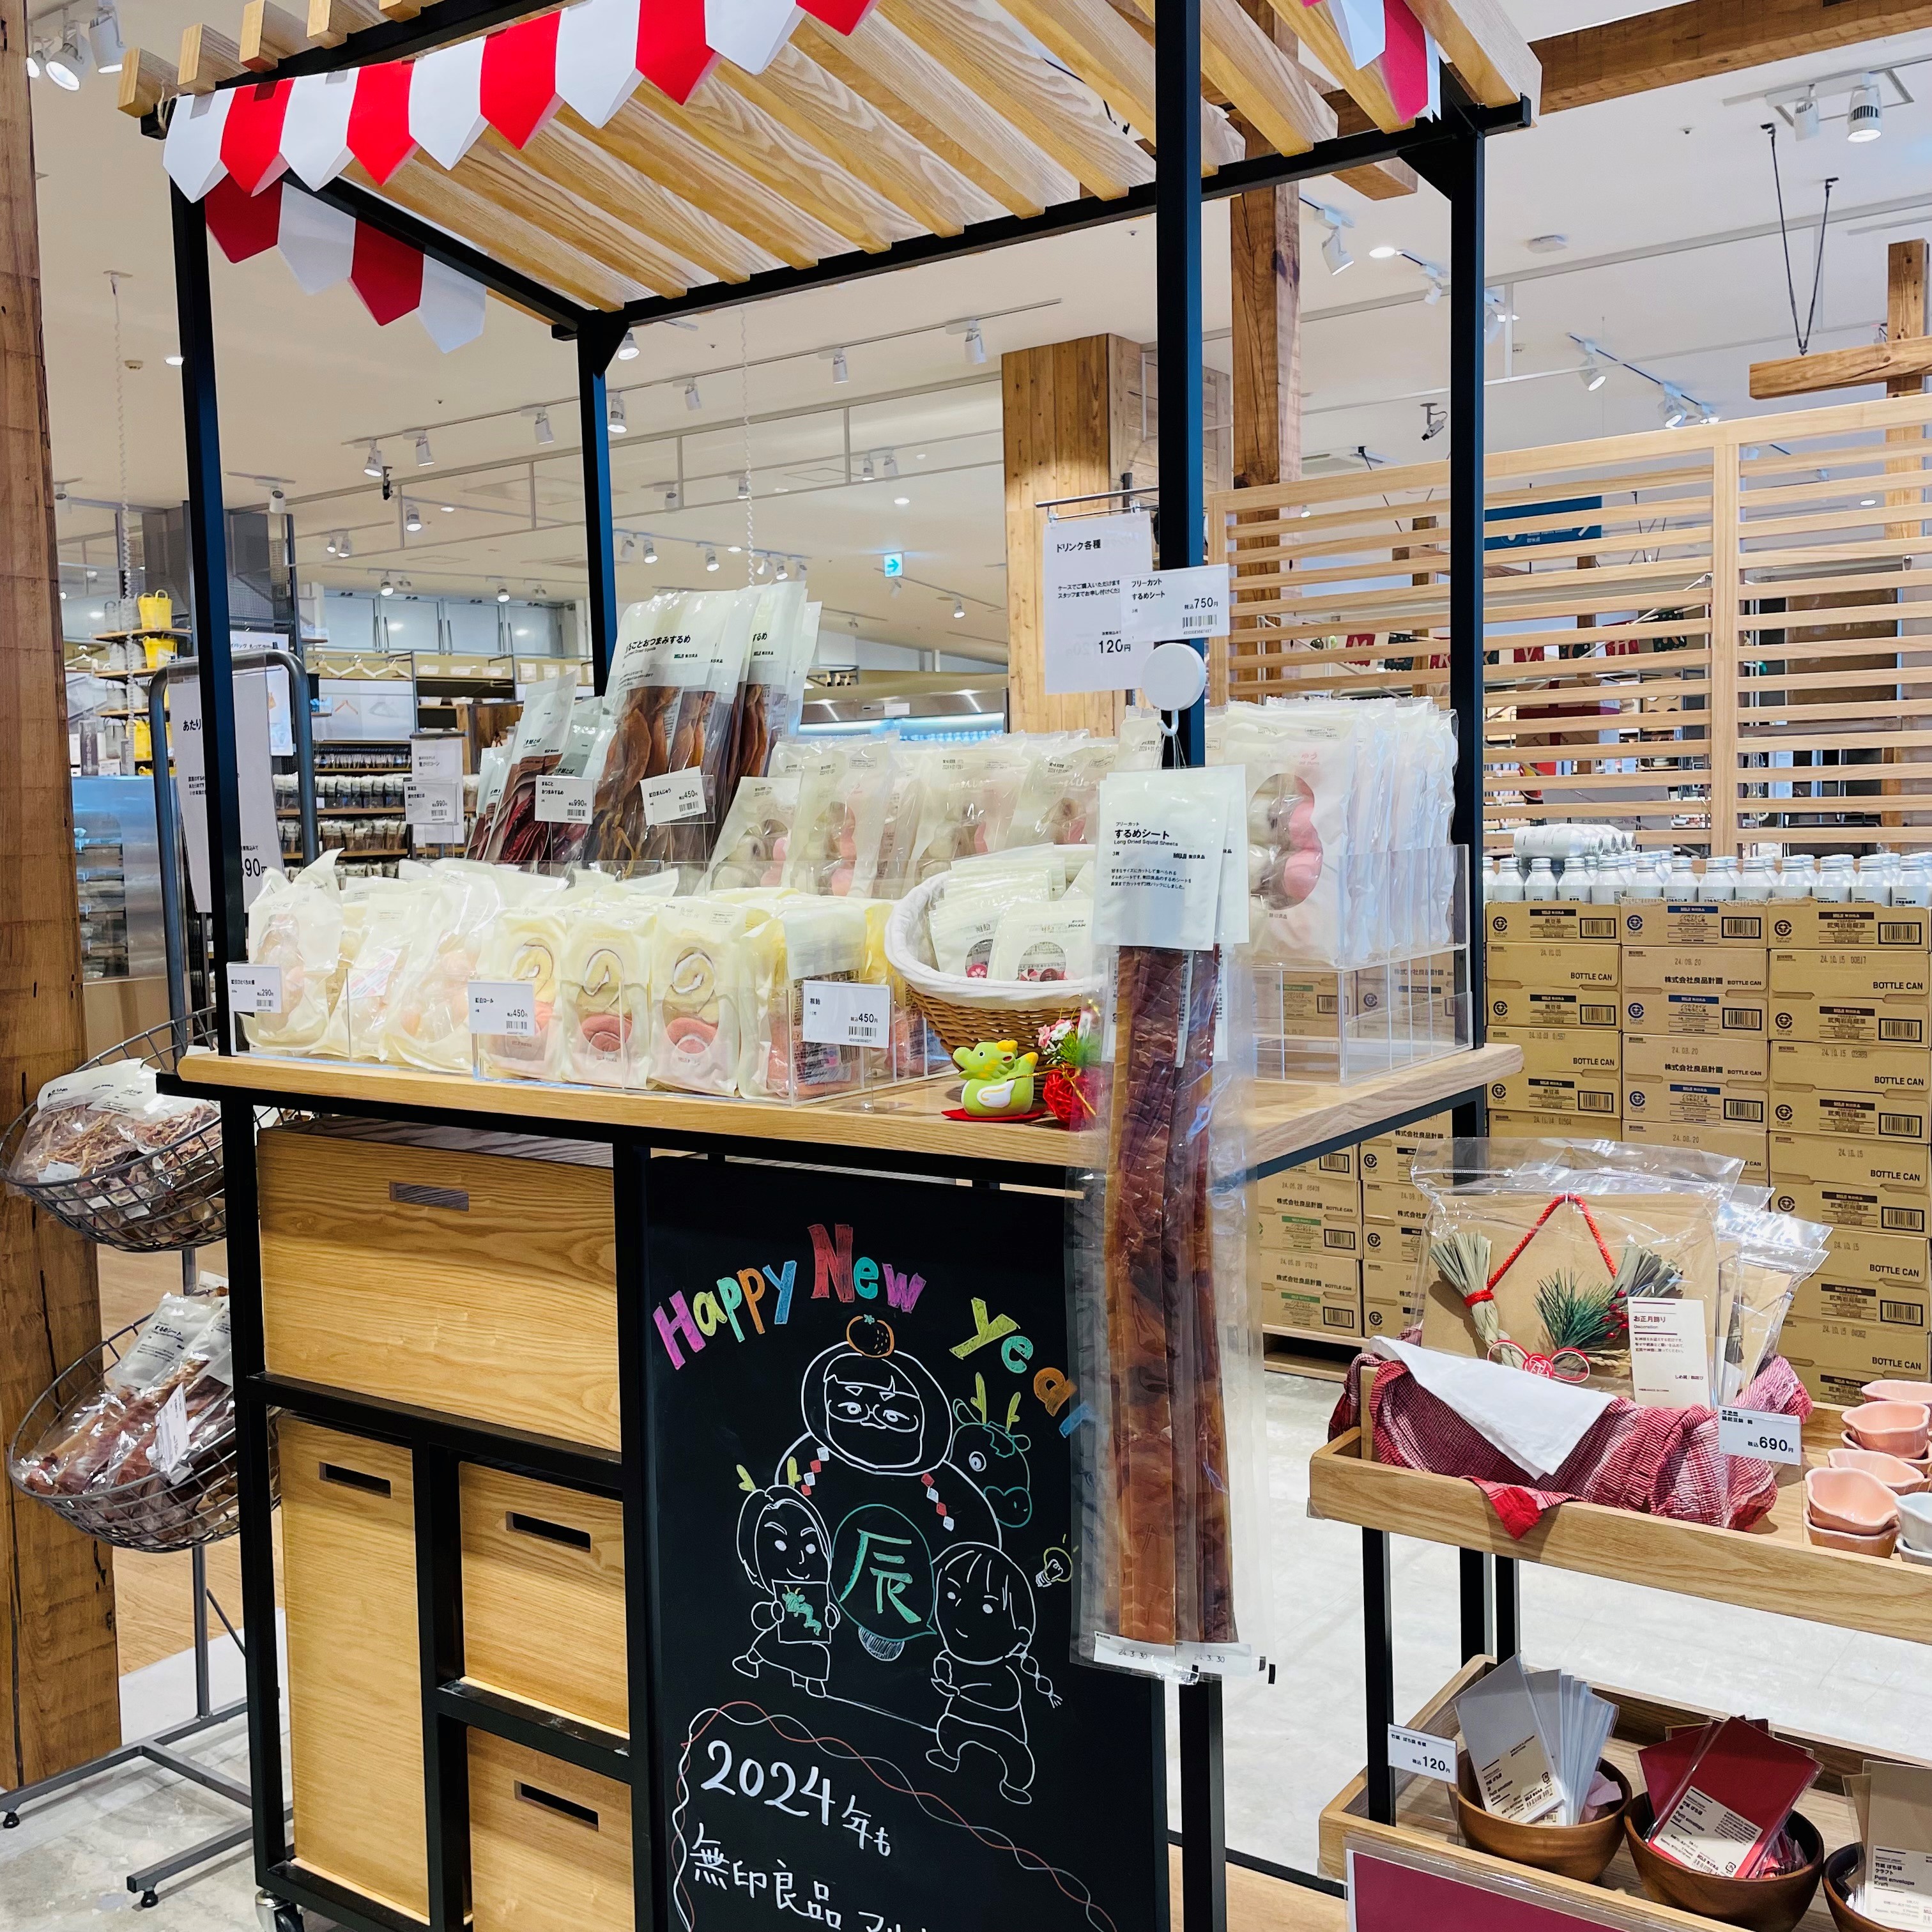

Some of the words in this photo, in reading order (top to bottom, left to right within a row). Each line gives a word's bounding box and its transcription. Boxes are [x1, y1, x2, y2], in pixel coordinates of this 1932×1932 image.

[1057, 539, 1101, 553] ドリンク各種
[1131, 578, 1162, 588] フリーカット
[1131, 590, 1165, 601] するめシート
[1184, 597, 1218, 610] 税込750円
[1099, 639, 1131, 654] 120円
[1115, 829, 1170, 840] するめシート
[1664, 976, 1723, 985] 株式会社良品計画
[1874, 1076, 1905, 1085] BOTTLE
[1870, 1169, 1901, 1179] BOTTLE
[1903, 1172, 1920, 1181] CAN
[1869, 1263, 1901, 1275] BOTTLE
[1902, 1268, 1919, 1277] CAN
[652, 1260, 797, 1370] Happy
[807, 1223, 927, 1314] New
[1872, 1356, 1902, 1368] BOTTLE
[1904, 1360, 1921, 1370] CAN
[1747, 1436, 1794, 1453] 税込690円
[838, 1528, 922, 1625] 辰
[1412, 1756, 1451, 1774] 税込120円
[700, 1739, 891, 1857] 2024年も
[689, 1822, 841, 1931] 無印良品
